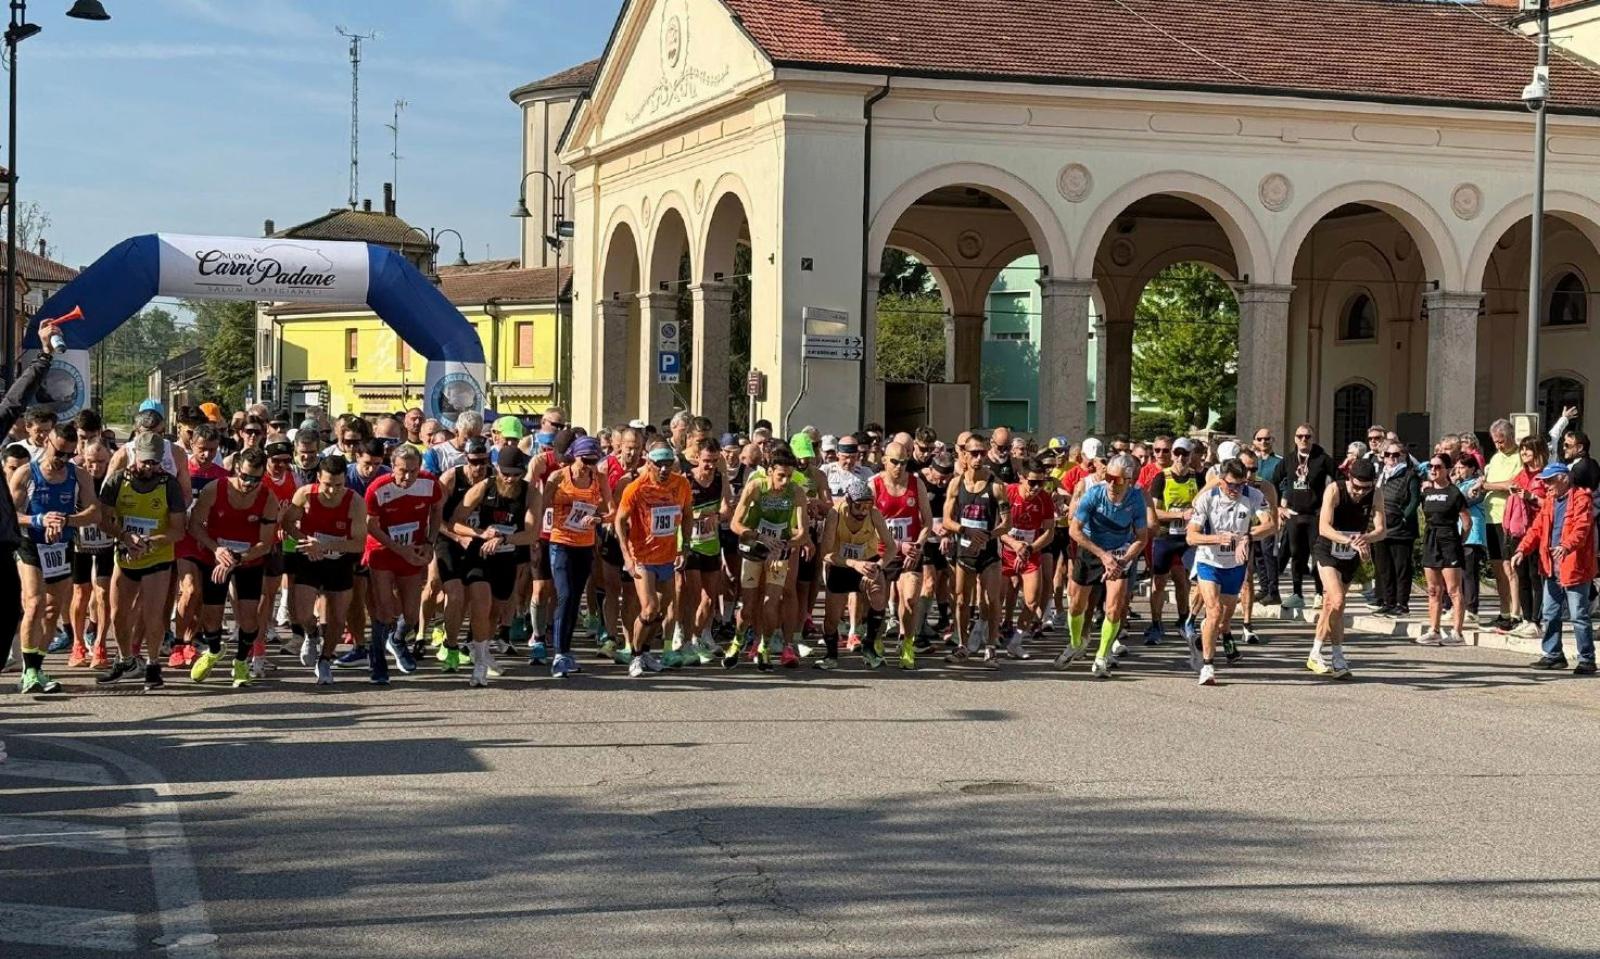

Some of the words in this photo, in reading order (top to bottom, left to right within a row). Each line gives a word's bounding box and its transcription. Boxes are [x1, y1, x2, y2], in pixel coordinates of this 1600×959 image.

[221, 252, 253, 261] NUOVA
[195, 249, 257, 276] Carni
[247, 258, 336, 286] Padane
[253, 287, 322, 295] ARTIGIANALI
[662, 354, 675, 371] P
[1425, 493, 1449, 502] NIKE
[655, 515, 671, 530] 793
[83, 526, 102, 542] 834
[43, 550, 63, 569] 806
